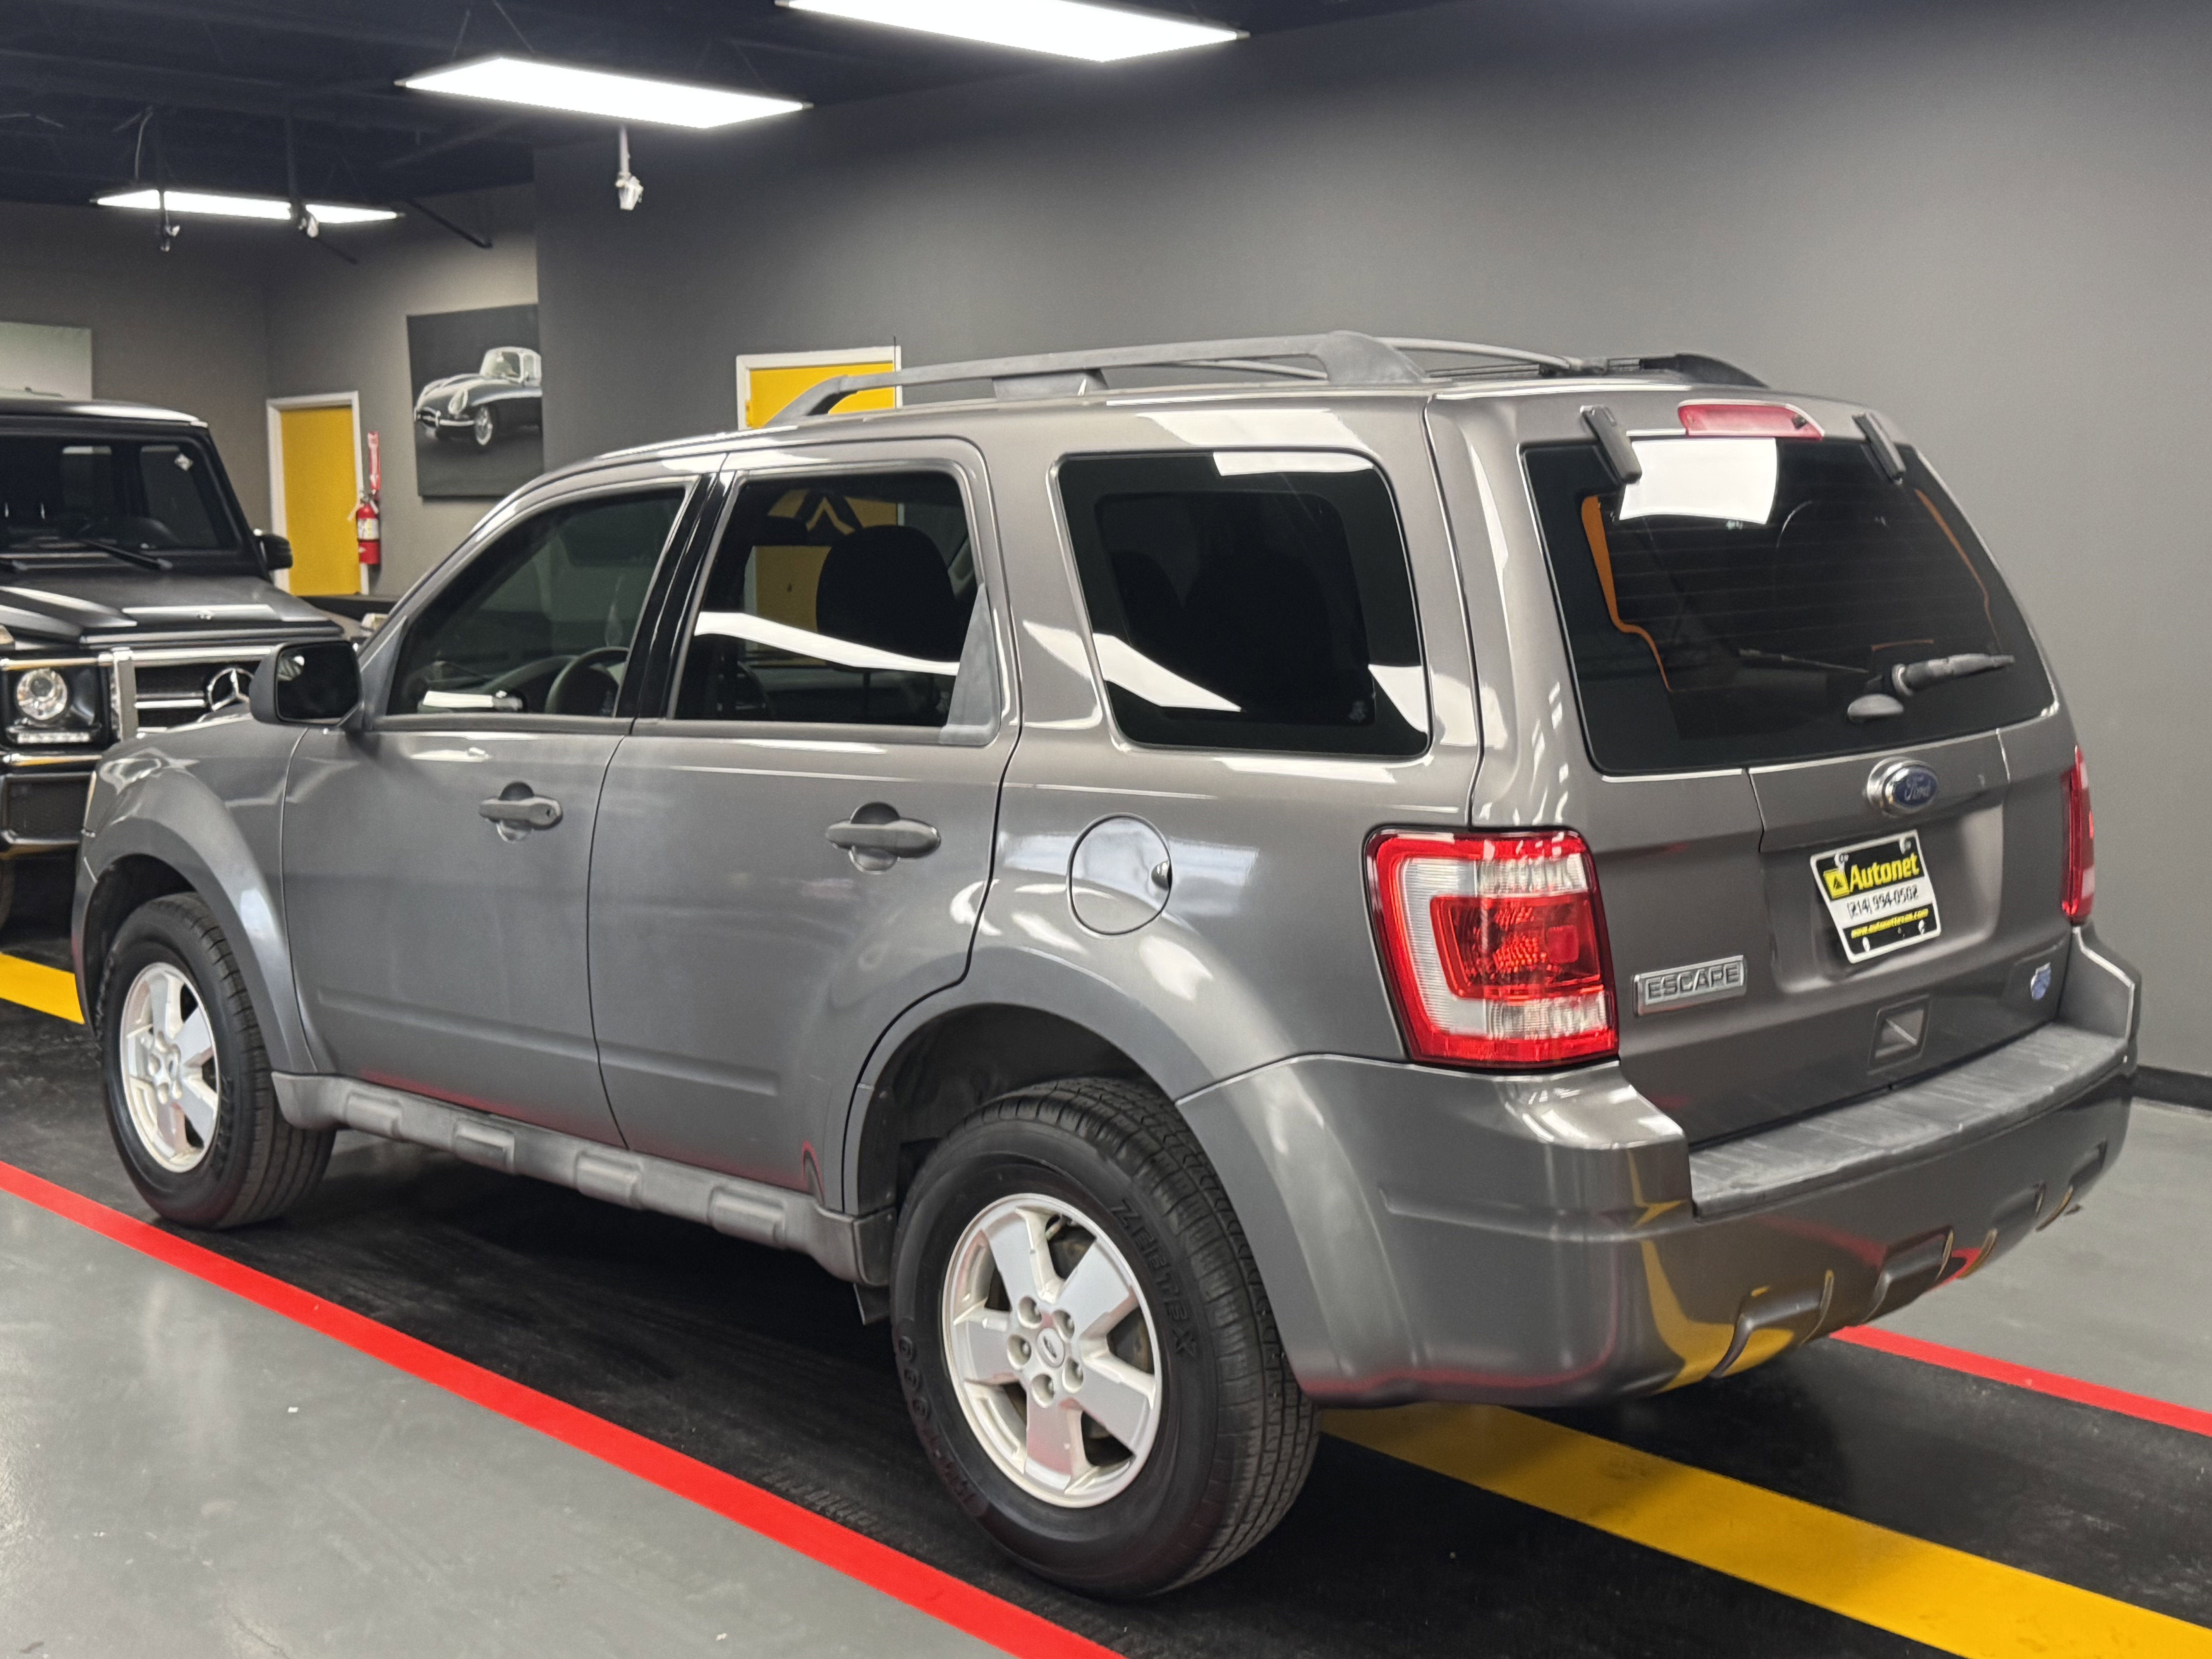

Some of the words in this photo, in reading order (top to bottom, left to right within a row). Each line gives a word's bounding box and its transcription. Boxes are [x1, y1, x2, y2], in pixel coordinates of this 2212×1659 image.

[1850, 853, 1920, 893] Autonet
[1846, 896, 1872, 919] (214)
[1645, 962, 1741, 1005] ESCAPE
